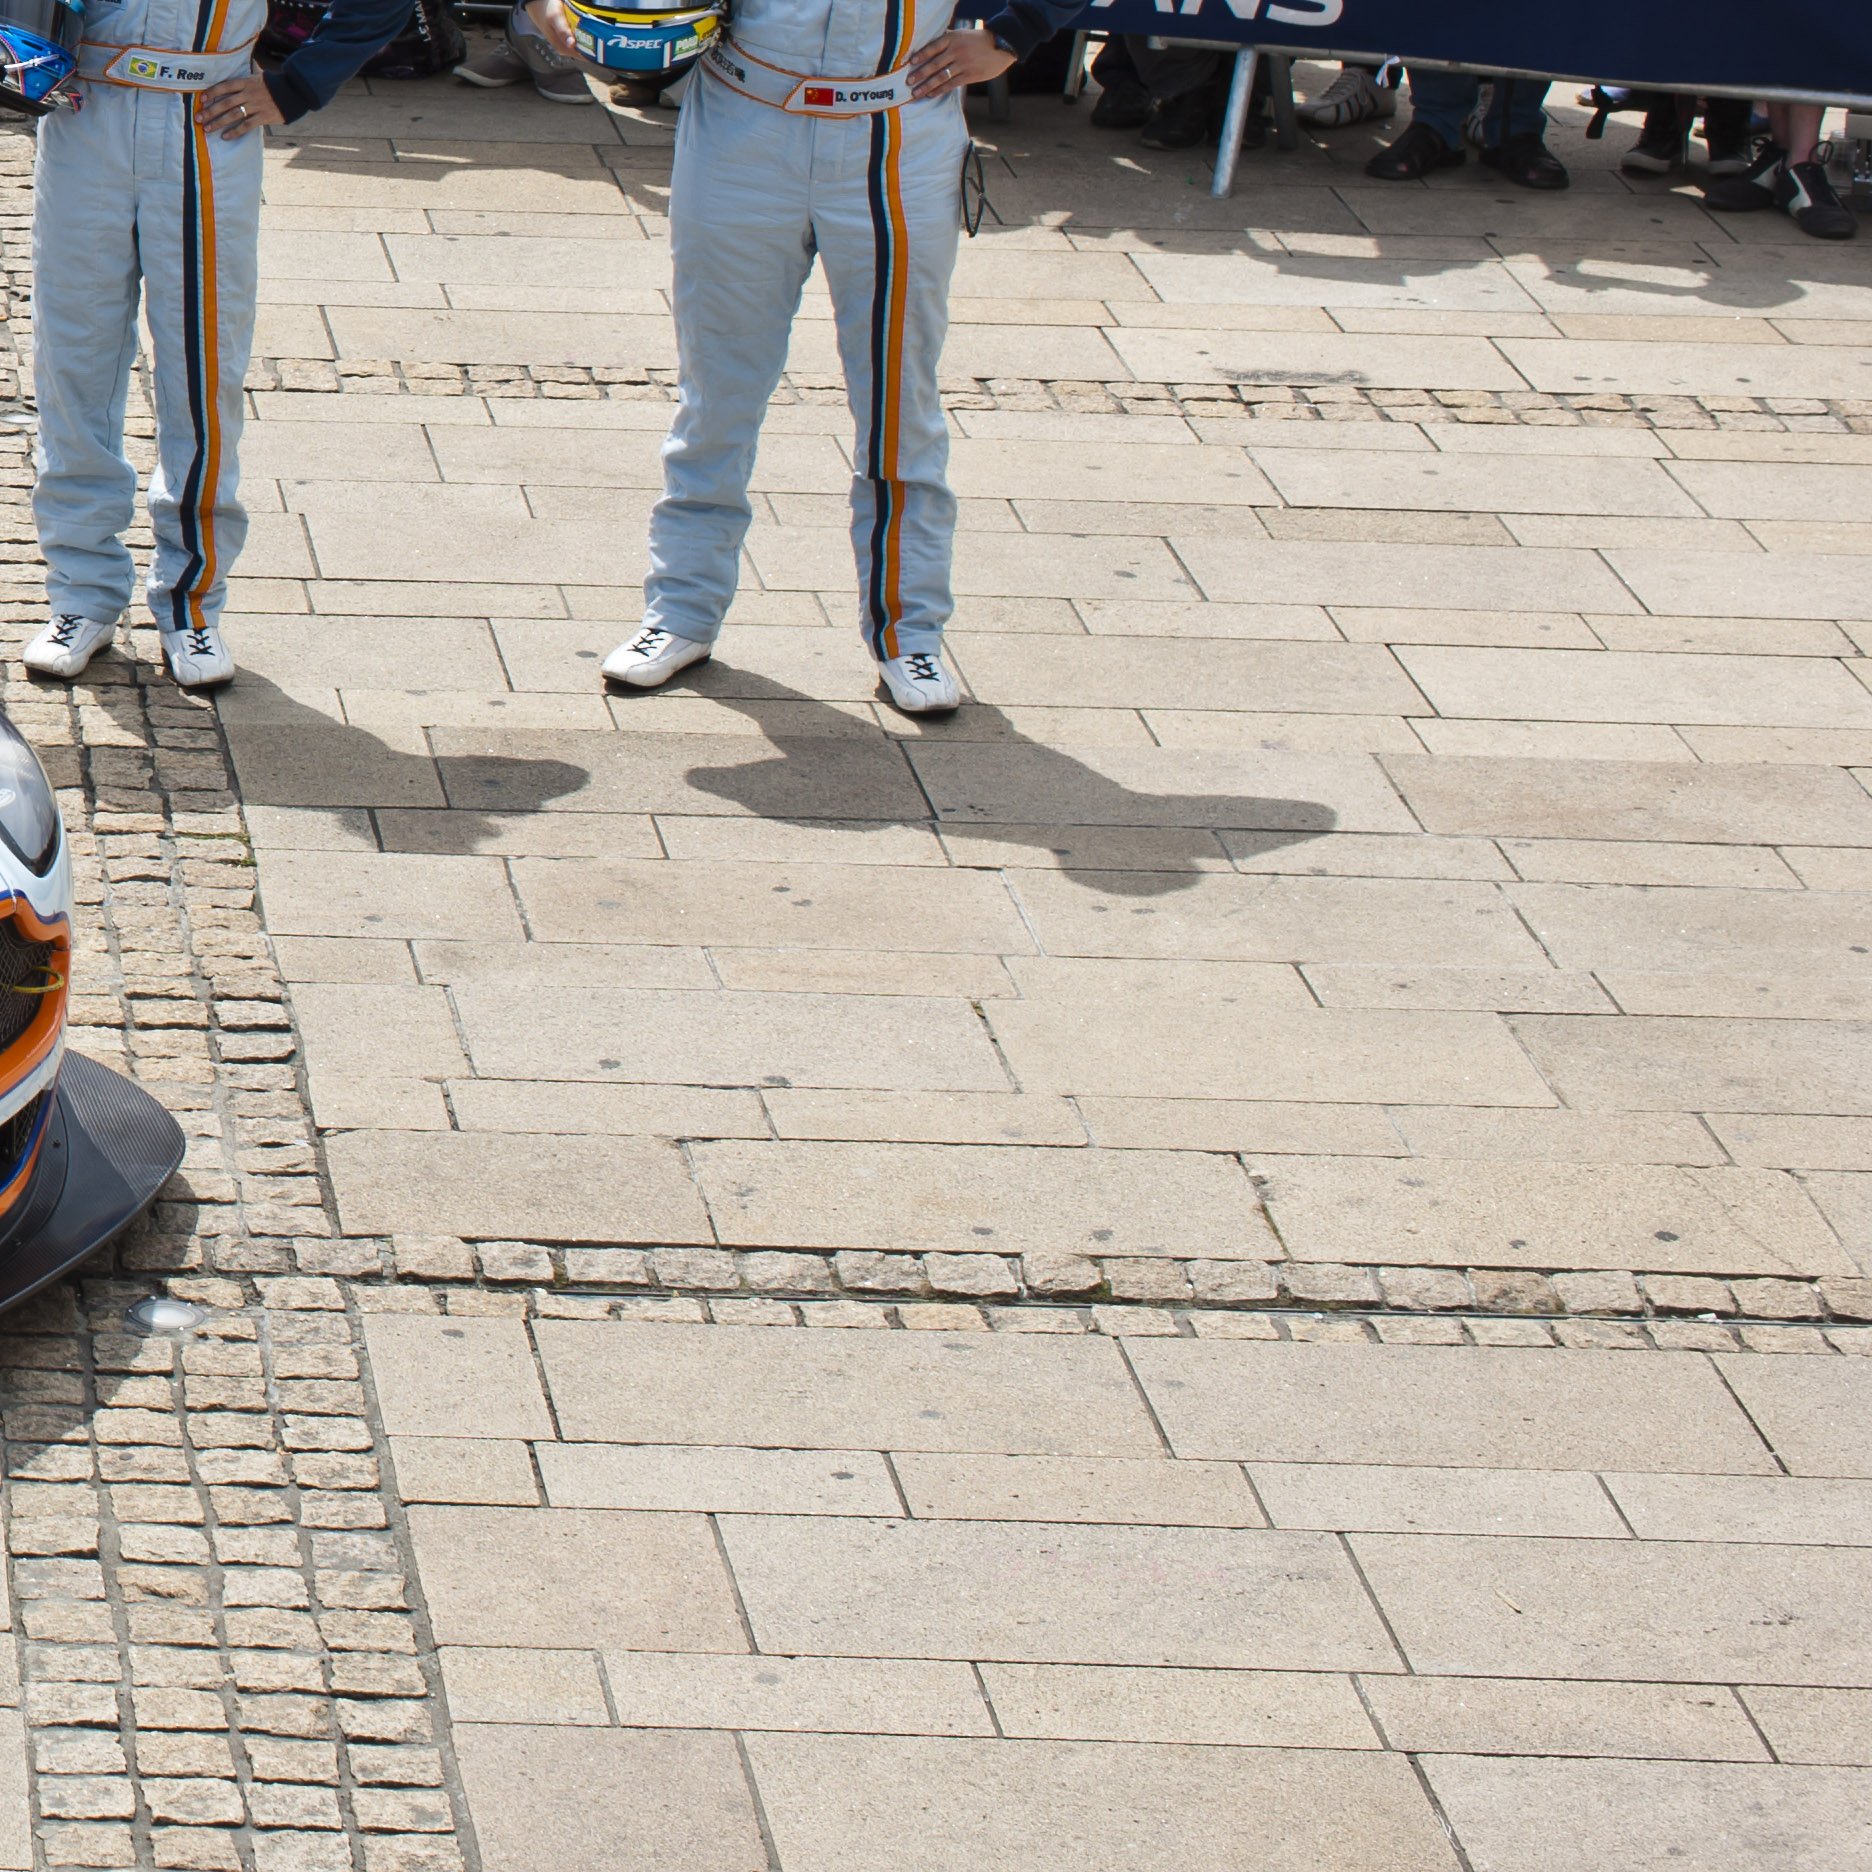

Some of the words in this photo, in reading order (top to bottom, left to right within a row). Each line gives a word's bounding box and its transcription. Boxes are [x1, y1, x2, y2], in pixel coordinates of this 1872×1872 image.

[160, 65, 173, 78] F.
[176, 68, 205, 81] Rees
[835, 91, 848, 104] D.
[850, 88, 895, 104] O'Young
